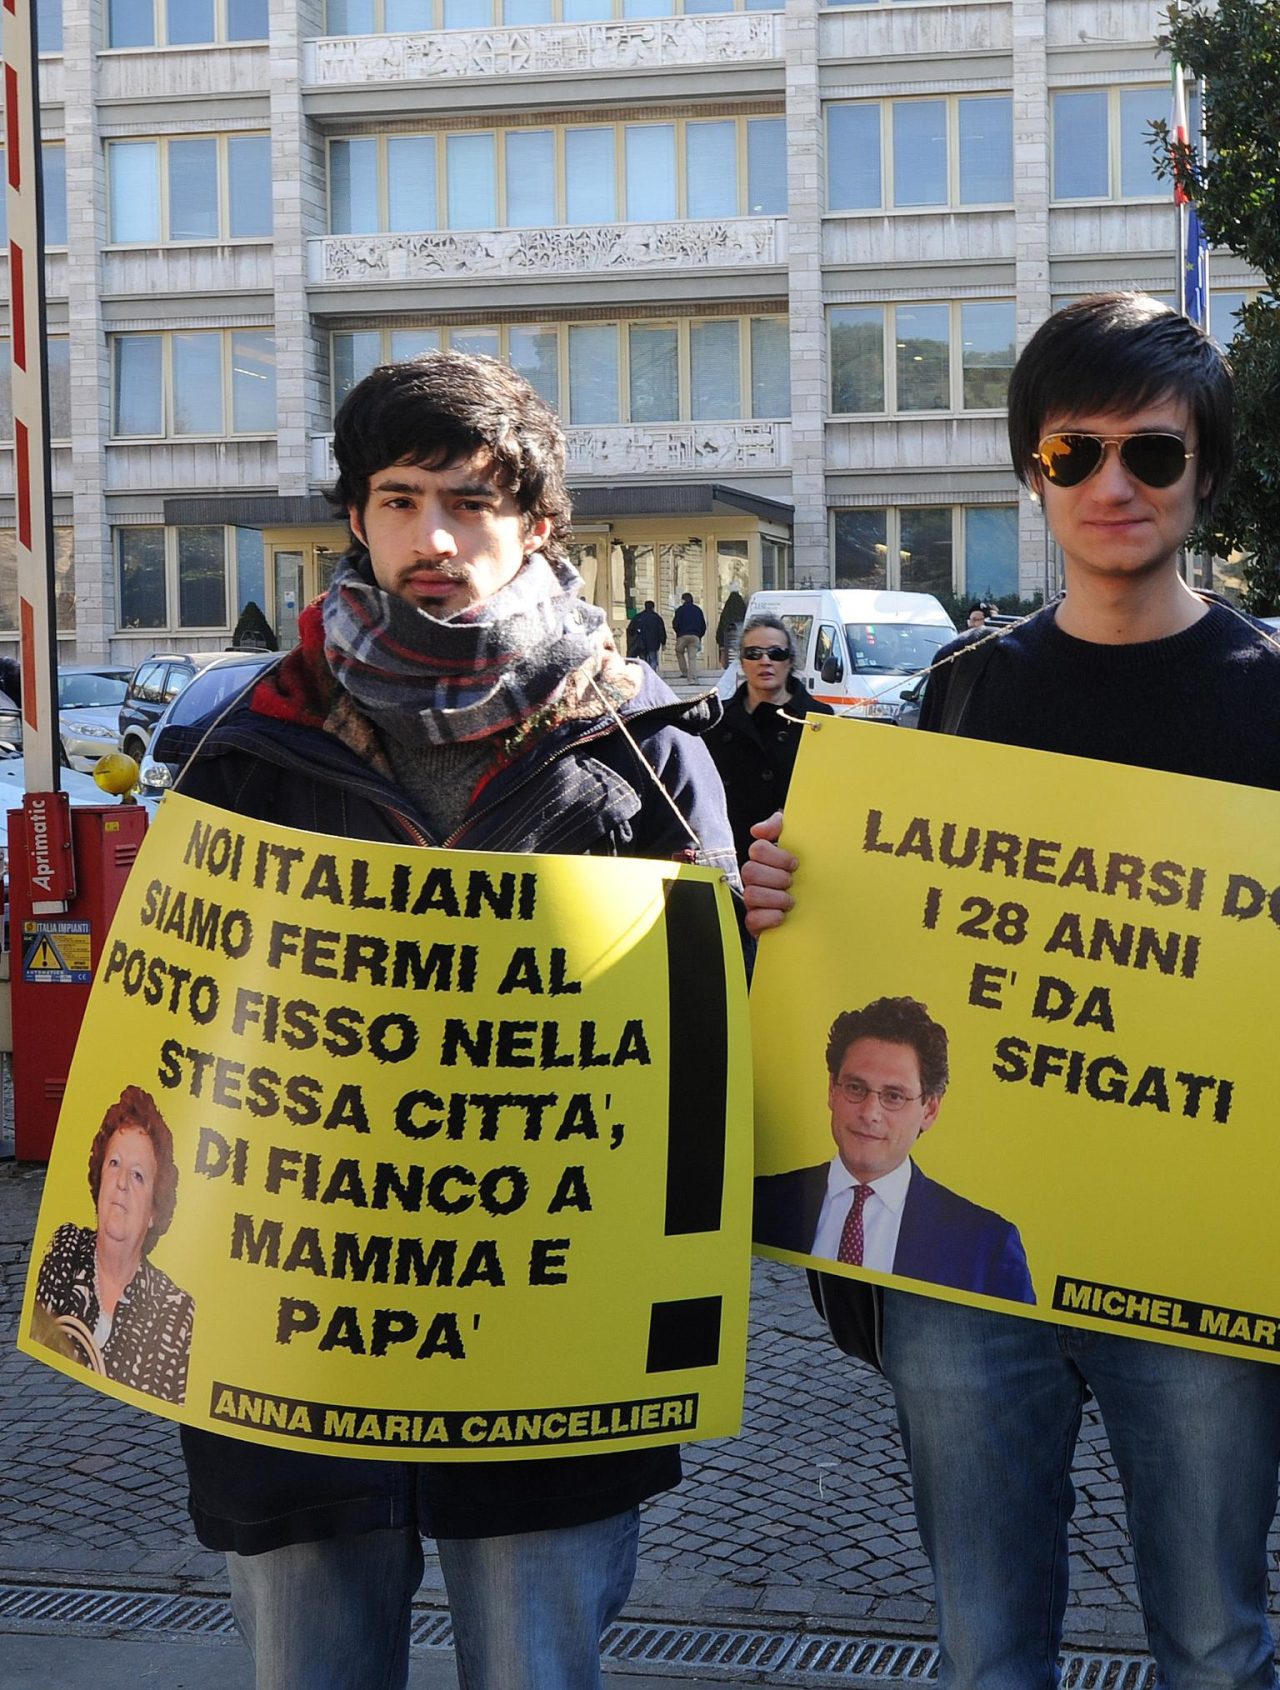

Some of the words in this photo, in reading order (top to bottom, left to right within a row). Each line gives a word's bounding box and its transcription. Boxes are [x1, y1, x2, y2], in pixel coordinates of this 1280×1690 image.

[30, 800, 54, 891] Aprimatic
[185, 820, 246, 882] NOI
[255, 841, 537, 920] ITALIANI
[864, 810, 1205, 910] LAUREARSI
[36, 922, 57, 933] ITALIA
[58, 922, 89, 933] IMPIANTI
[140, 878, 252, 960] SIAMO
[268, 922, 479, 993] FERMI
[497, 947, 581, 997] AL
[923, 888, 941, 929] I
[957, 897, 1029, 945] 28
[1044, 913, 1200, 978] ANNI
[105, 941, 218, 1025] POSTO
[235, 989, 420, 1065] FISSO
[440, 1019, 651, 1071] NELLA
[969, 964, 1016, 1009] E'
[1032, 976, 1114, 1032] DA
[158, 1039, 370, 1133] STESSA
[393, 1090, 624, 1150] CITTA',
[993, 1036, 1234, 1123] SFIGATI
[194, 1127, 249, 1186] DI
[265, 1147, 529, 1217] FIANCO
[547, 1166, 592, 1214] A
[231, 1213, 505, 1288] MAMMA
[529, 1238, 570, 1286] E
[276, 1297, 480, 1360] PAPA'
[1061, 1281, 1189, 1330] MICHEL
[214, 1390, 312, 1435] ANNA
[323, 1412, 450, 1444] MARIA
[461, 1398, 694, 1444] CANCELLIERI
